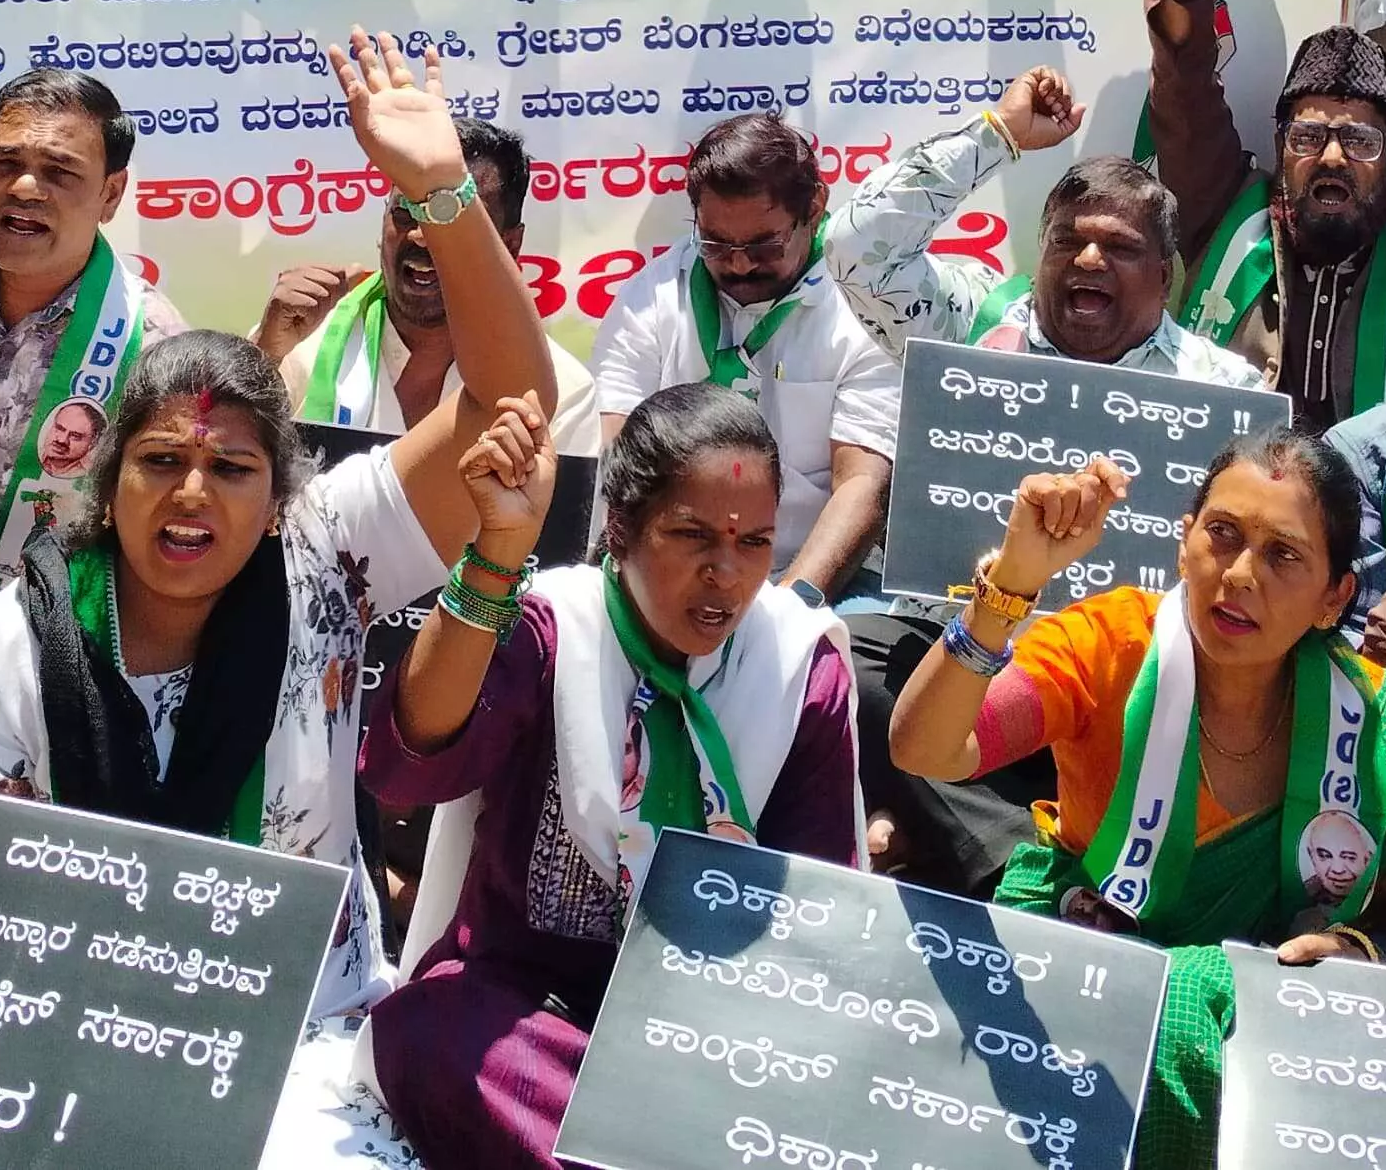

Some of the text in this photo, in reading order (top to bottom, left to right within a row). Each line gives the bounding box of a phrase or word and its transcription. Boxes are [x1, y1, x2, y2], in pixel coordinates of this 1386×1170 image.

[497, 18, 621, 67] ಗ್ರೇಟರ್
[643, 13, 834, 50] ಬೆಂಗಳೂರು
[854, 7, 1096, 53] ವಿಧೇಯಕವನ್ನು
[521, 79, 660, 119] ಮಾಡಲು
[940, 367, 1210, 441] ಧಿಕ್ಕಾರ ಧಿಕ್ಕಾರ
[6, 837, 150, 912] ದರವನ್ನು
[175, 868, 280, 936] ಹೆಚ್ಚಳ
[88, 931, 273, 998] ನಡೆಸುತ್ತಿರುವ
[693, 870, 1108, 999] ಧಿಕ್ಕಾರ ! ಧಿಕ್ಕಾರ !!
[79, 1003, 244, 1099] ಸರ್ಕಾರಕ್ಕೆ
[644, 1017, 838, 1089] ಕಾಂಗ್ರೆಸ್
[662, 943, 1098, 1097] ಜನವಿರೋಧಿ ರಾಜ್ಯ
[54, 1093, 78, 1141] !
